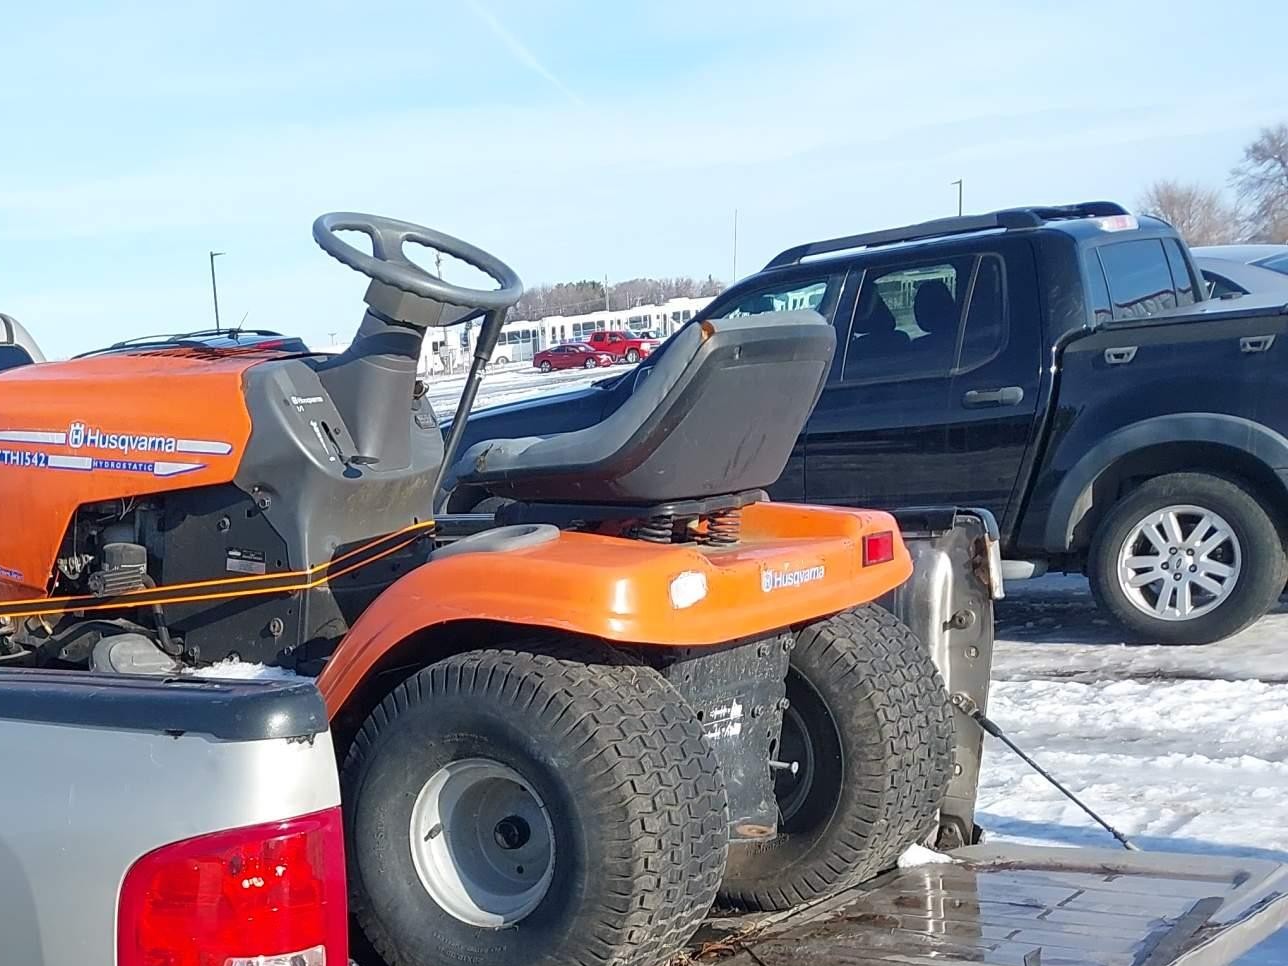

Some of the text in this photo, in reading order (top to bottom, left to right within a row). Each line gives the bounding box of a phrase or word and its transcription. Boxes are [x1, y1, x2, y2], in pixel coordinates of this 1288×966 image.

[86, 428, 177, 455] Husqvarna
[93, 460, 153, 472] HYDROSTATIC
[773, 566, 825, 588] Husqvarna
